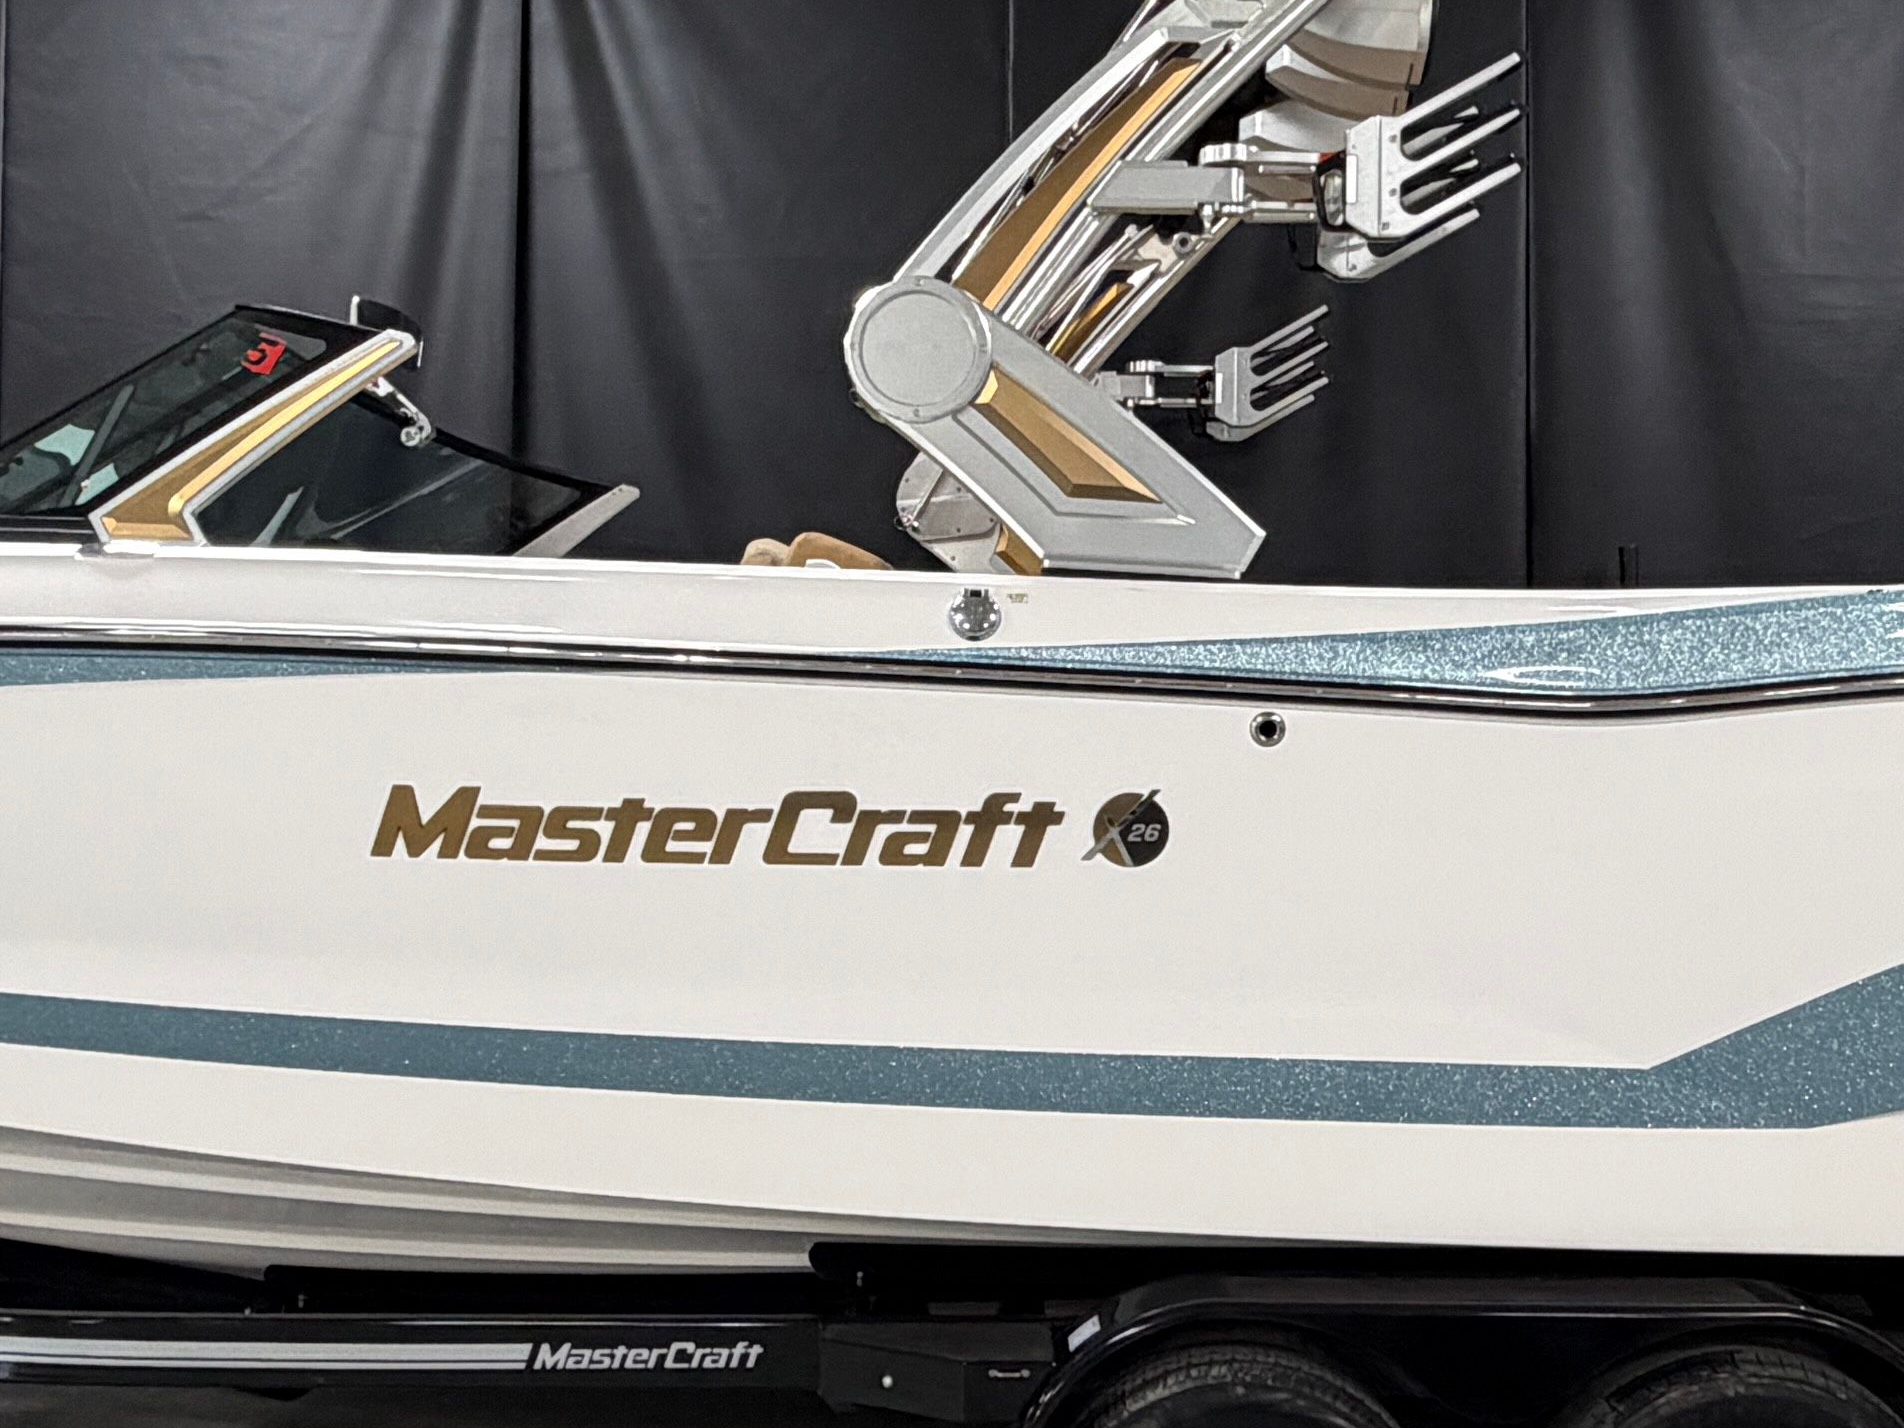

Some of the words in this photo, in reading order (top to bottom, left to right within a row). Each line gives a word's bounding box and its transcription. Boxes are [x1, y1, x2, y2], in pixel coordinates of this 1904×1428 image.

[370, 784, 1065, 868] MasterCraft
[1127, 823, 1162, 843] 26
[532, 1341, 764, 1370] MasterCraft
